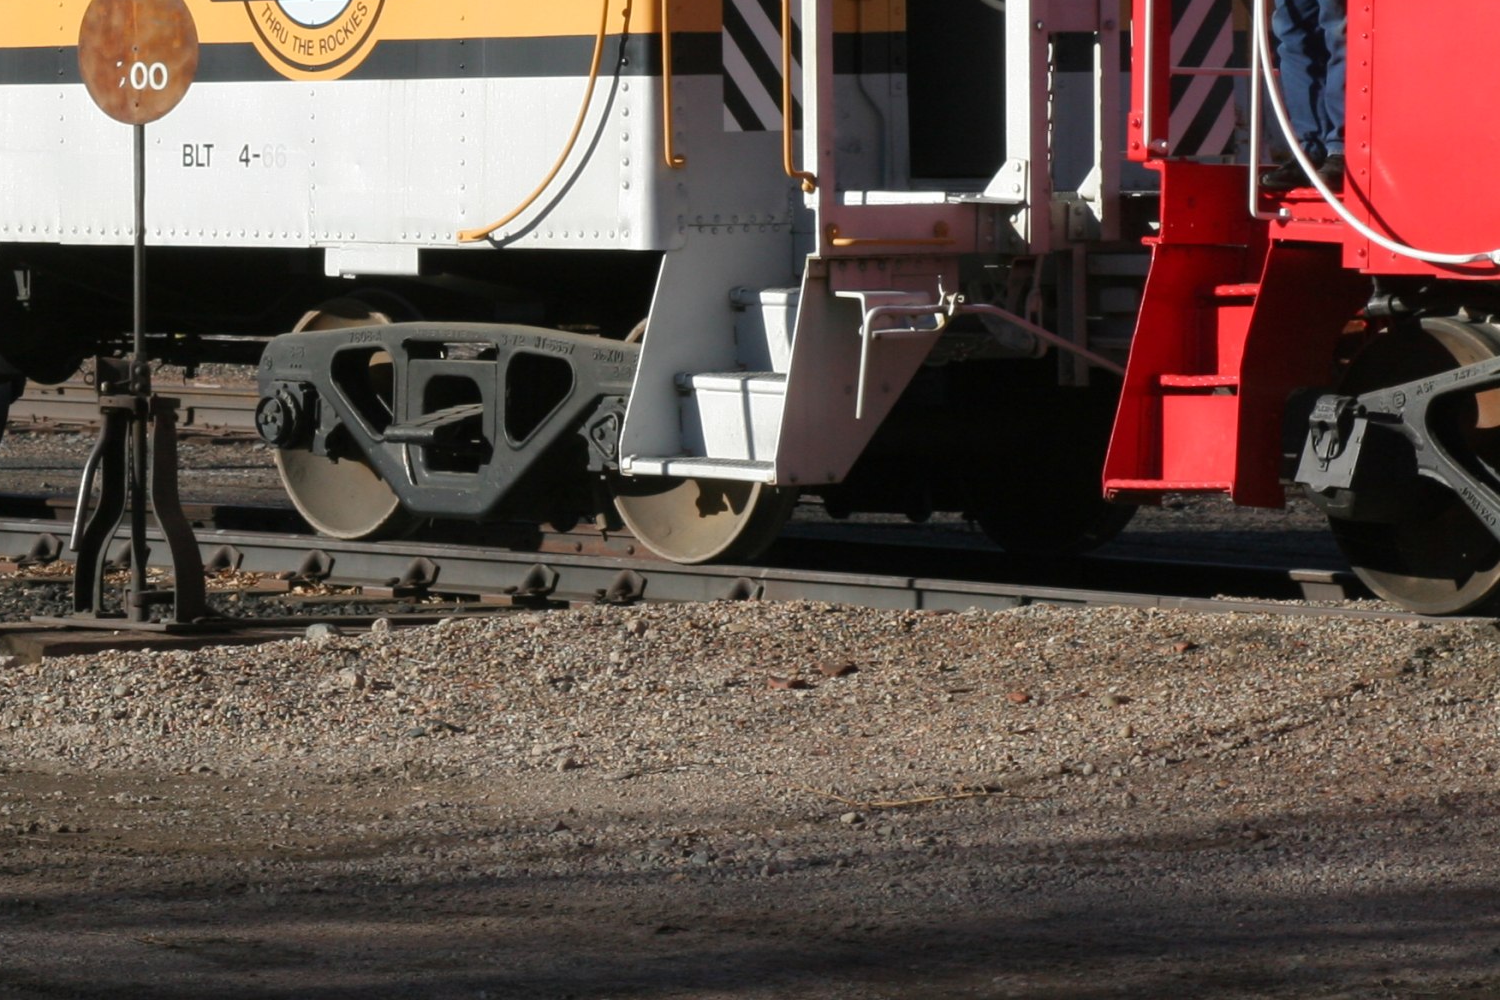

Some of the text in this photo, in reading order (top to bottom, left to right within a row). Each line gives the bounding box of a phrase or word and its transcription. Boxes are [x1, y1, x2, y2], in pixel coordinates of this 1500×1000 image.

[260, 0, 369, 56] THRU THE ROCKIES
[182, 143, 215, 168] BLT
